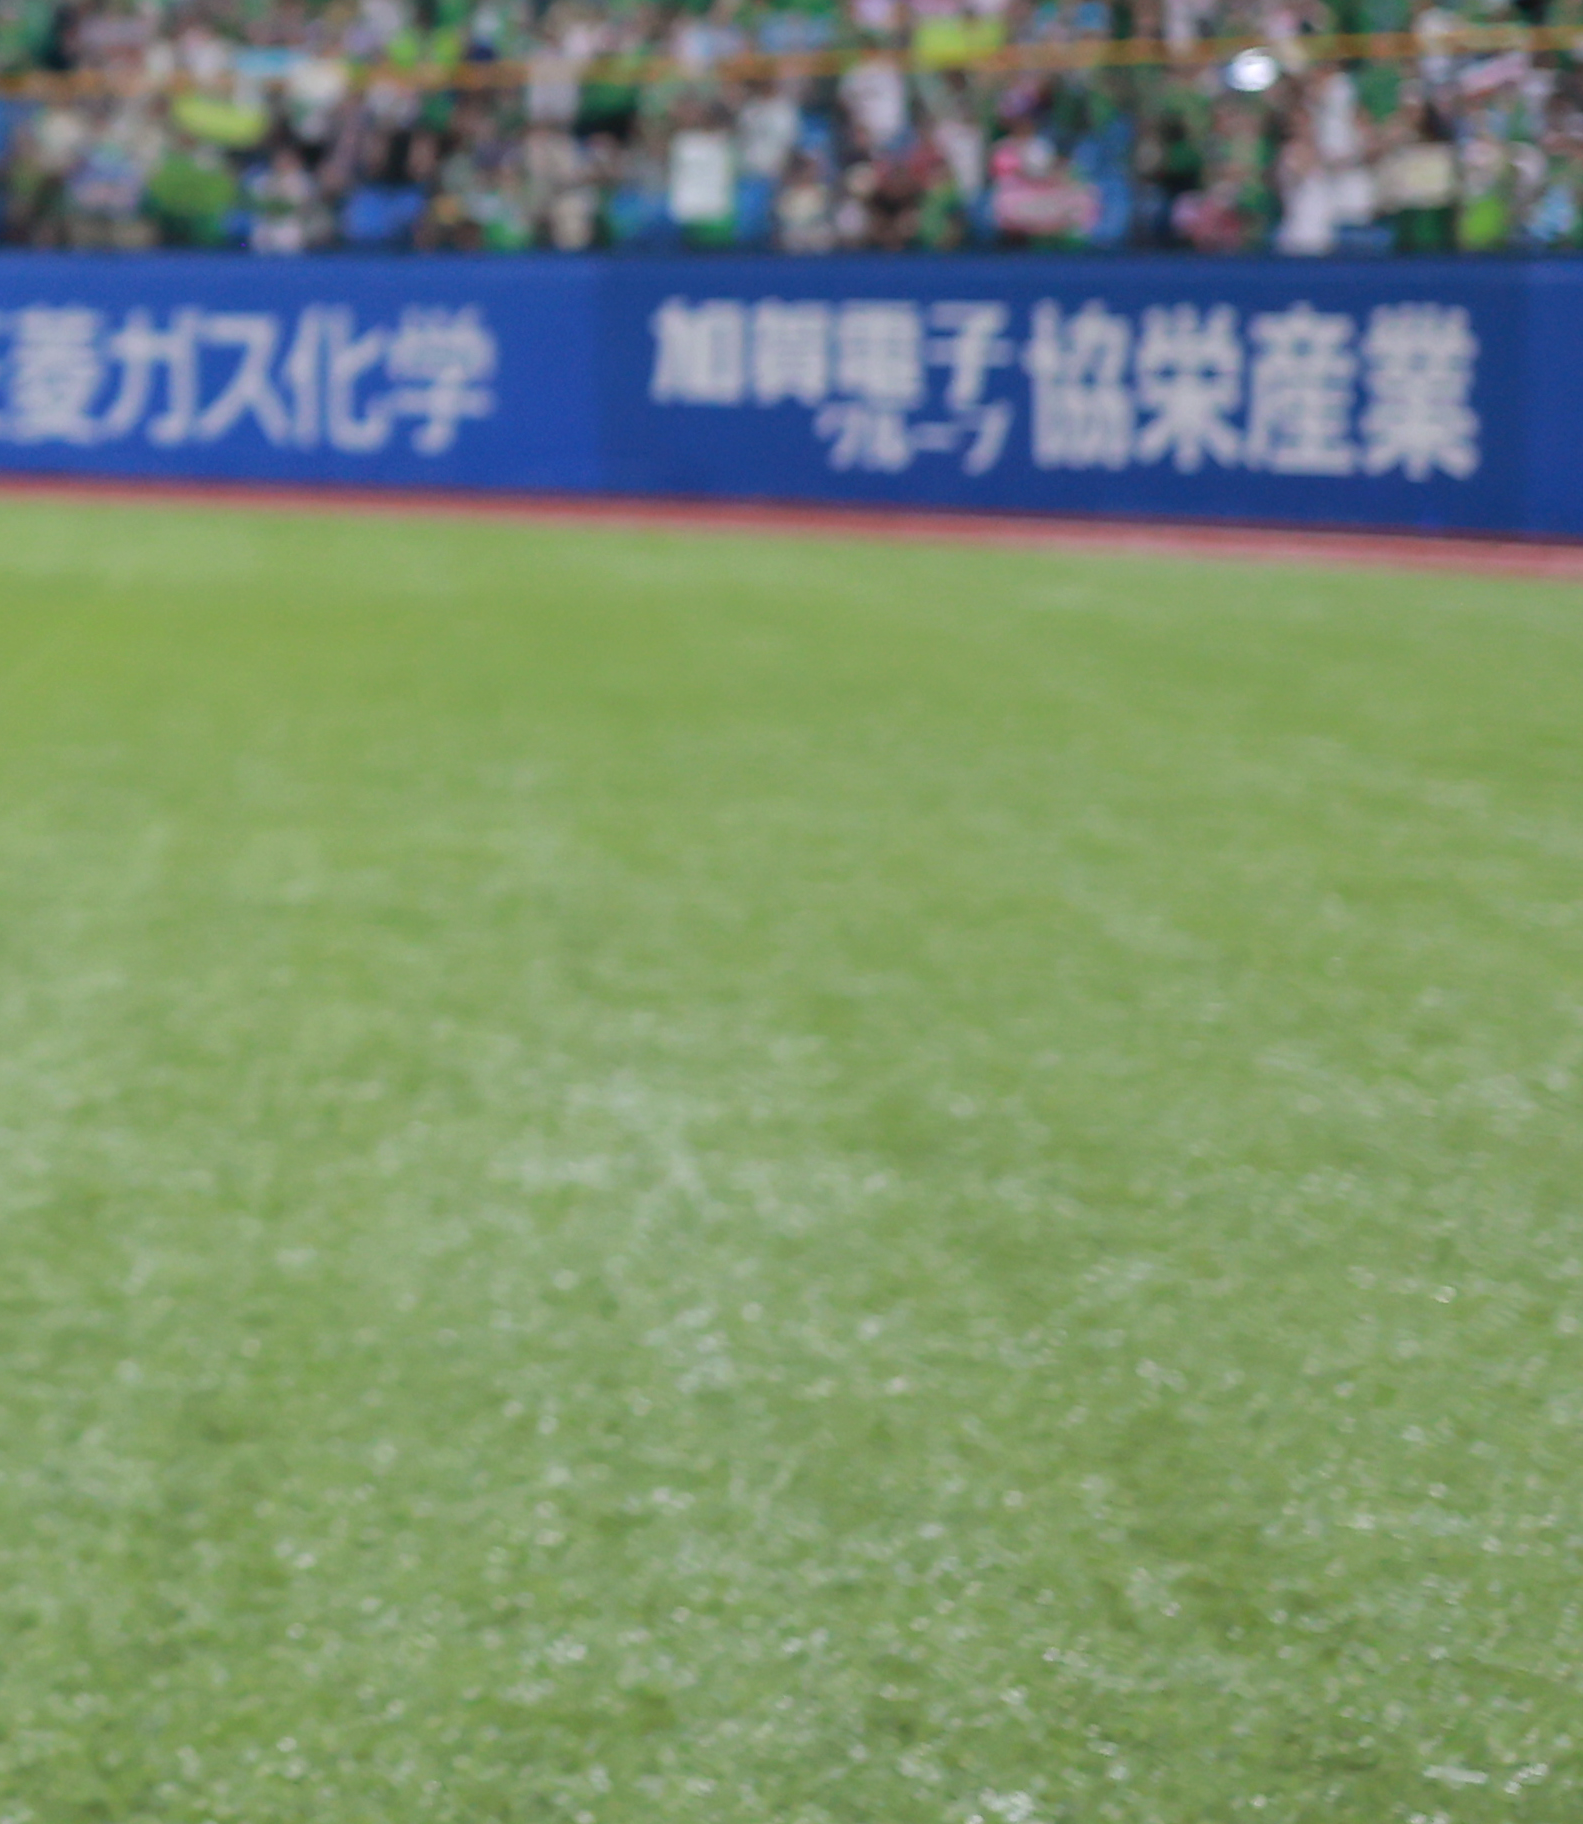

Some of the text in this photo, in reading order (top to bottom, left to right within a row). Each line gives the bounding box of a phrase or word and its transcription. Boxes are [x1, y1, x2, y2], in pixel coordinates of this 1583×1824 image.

[650, 295, 1012, 410] 加賀電子
[1024, 298, 1480, 482] 協栄産業
